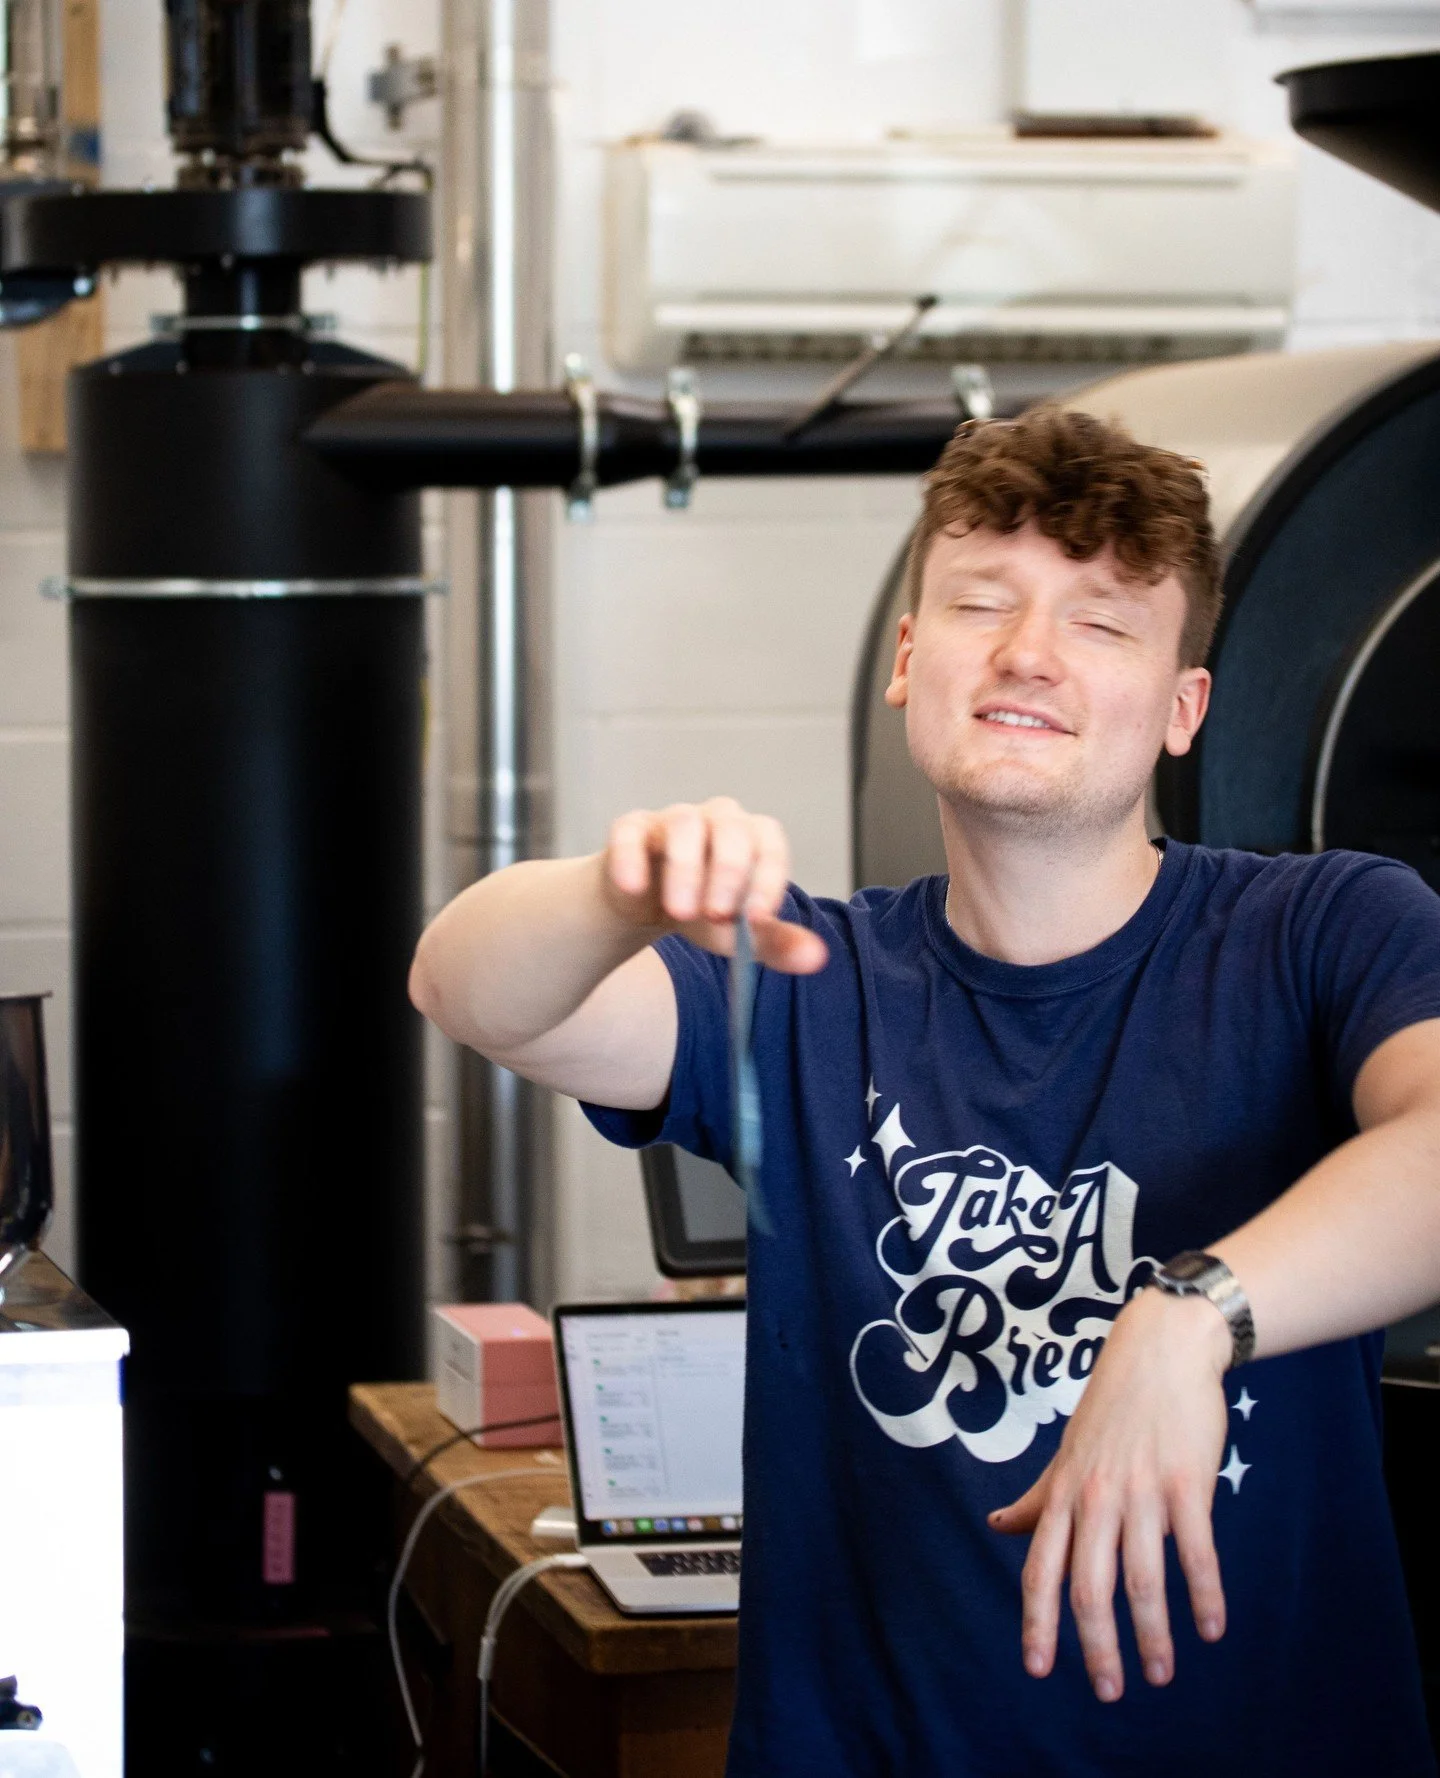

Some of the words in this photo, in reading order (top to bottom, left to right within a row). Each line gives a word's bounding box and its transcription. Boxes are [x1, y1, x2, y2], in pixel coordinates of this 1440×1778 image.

[881, 1148, 1061, 1276] Take
[1004, 1165, 1121, 1311] A
[854, 1260, 1152, 1435] Brea
